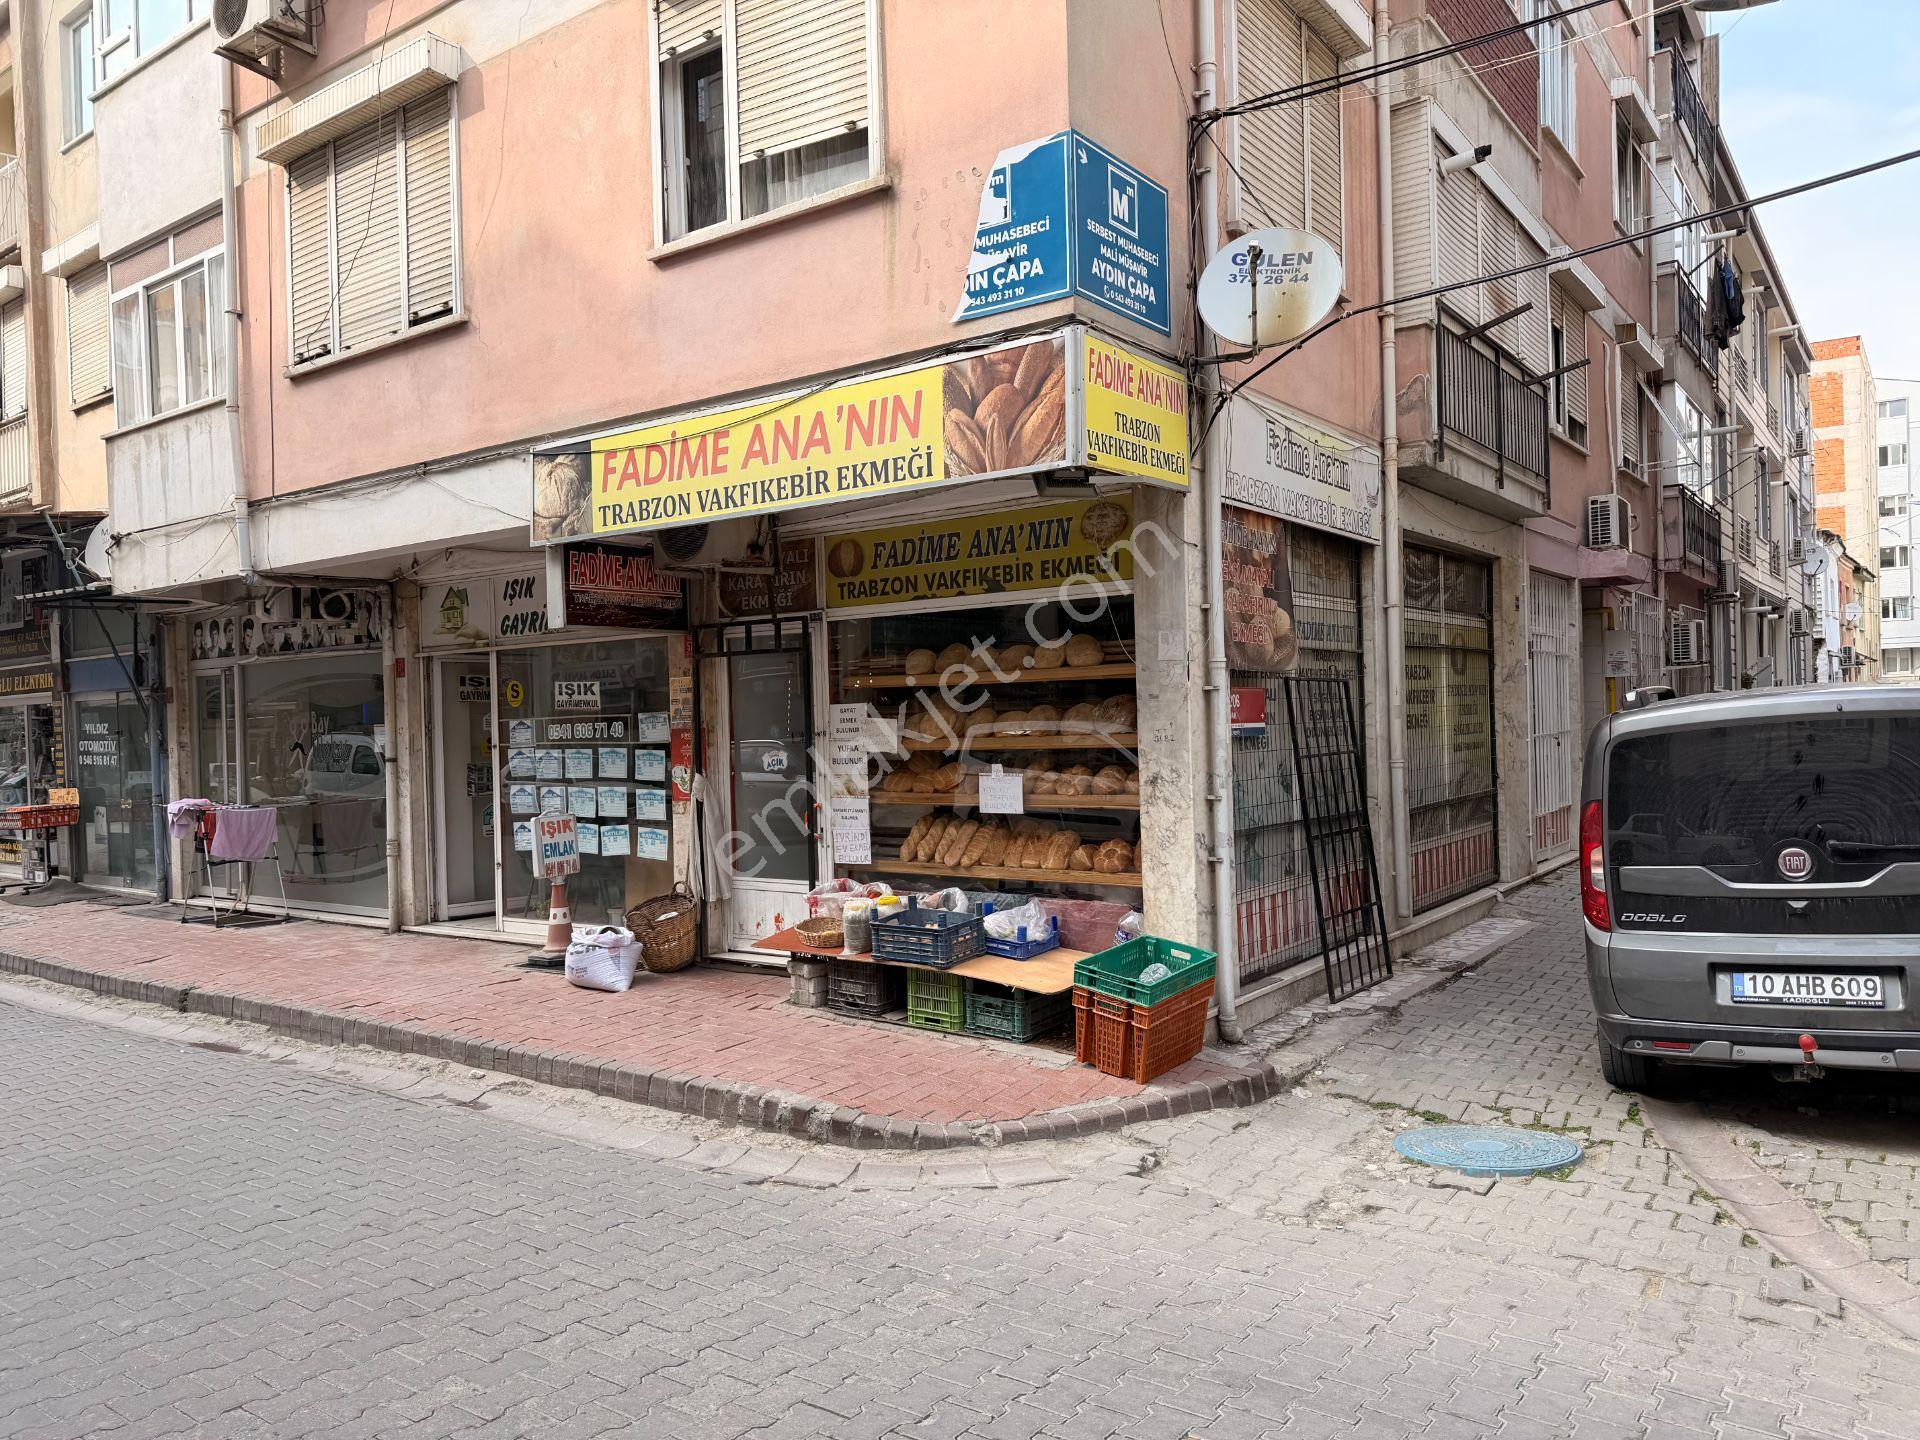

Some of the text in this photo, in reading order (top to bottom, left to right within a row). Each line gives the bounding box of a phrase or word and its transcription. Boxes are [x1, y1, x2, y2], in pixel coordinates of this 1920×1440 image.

[1112, 188, 1129, 223] M
[976, 215, 1050, 249] MUHASEBECİ
[1087, 218, 1159, 267] SERBEST MUHASEBECİ
[993, 257, 1044, 290] ÇAPA
[1100, 243, 1148, 278] MALİ MÜŞAVİR
[988, 291, 1002, 303] 493
[1004, 289, 1013, 299] 31
[1015, 286, 1025, 297] 10
[1091, 257, 1156, 304] AYDIN ÇAPA
[1263, 275, 1284, 285] 26
[1289, 273, 1310, 283] 44
[1088, 347, 1184, 416] FADİME ANA'NIN
[601, 389, 923, 493] FADİME ANA'NIN
[1115, 411, 1161, 444] TRABZON
[1087, 429, 1185, 475] VAKFIKEBİR EKMEĞİ
[599, 445, 934, 527] TRABZON VAKFIKEBİR EKMEĞİ
[1226, 471, 1279, 511] TRABZON
[871, 516, 1074, 570] FADİME ANA'NIN
[569, 547, 622, 588] FADİME
[838, 576, 919, 600] TRABZON
[924, 557, 1034, 592] VAKFIKEBİR
[503, 576, 535, 606] IŞIK
[511, 683, 520, 699] S
[558, 683, 597, 699] IŞIK
[79, 738, 116, 752] OTOMOTİV
[85, 723, 109, 735] YILDIZ
[548, 721, 625, 740] 0541 606 71 40
[767, 759, 784, 770] AÇIK
[541, 819, 574, 838] IŞIK
[543, 840, 576, 859] EMLAK
[1785, 856, 1805, 870] FIAT
[1621, 913, 1687, 923] DOBLO
[1748, 974, 1878, 998] 10 AHB 609
